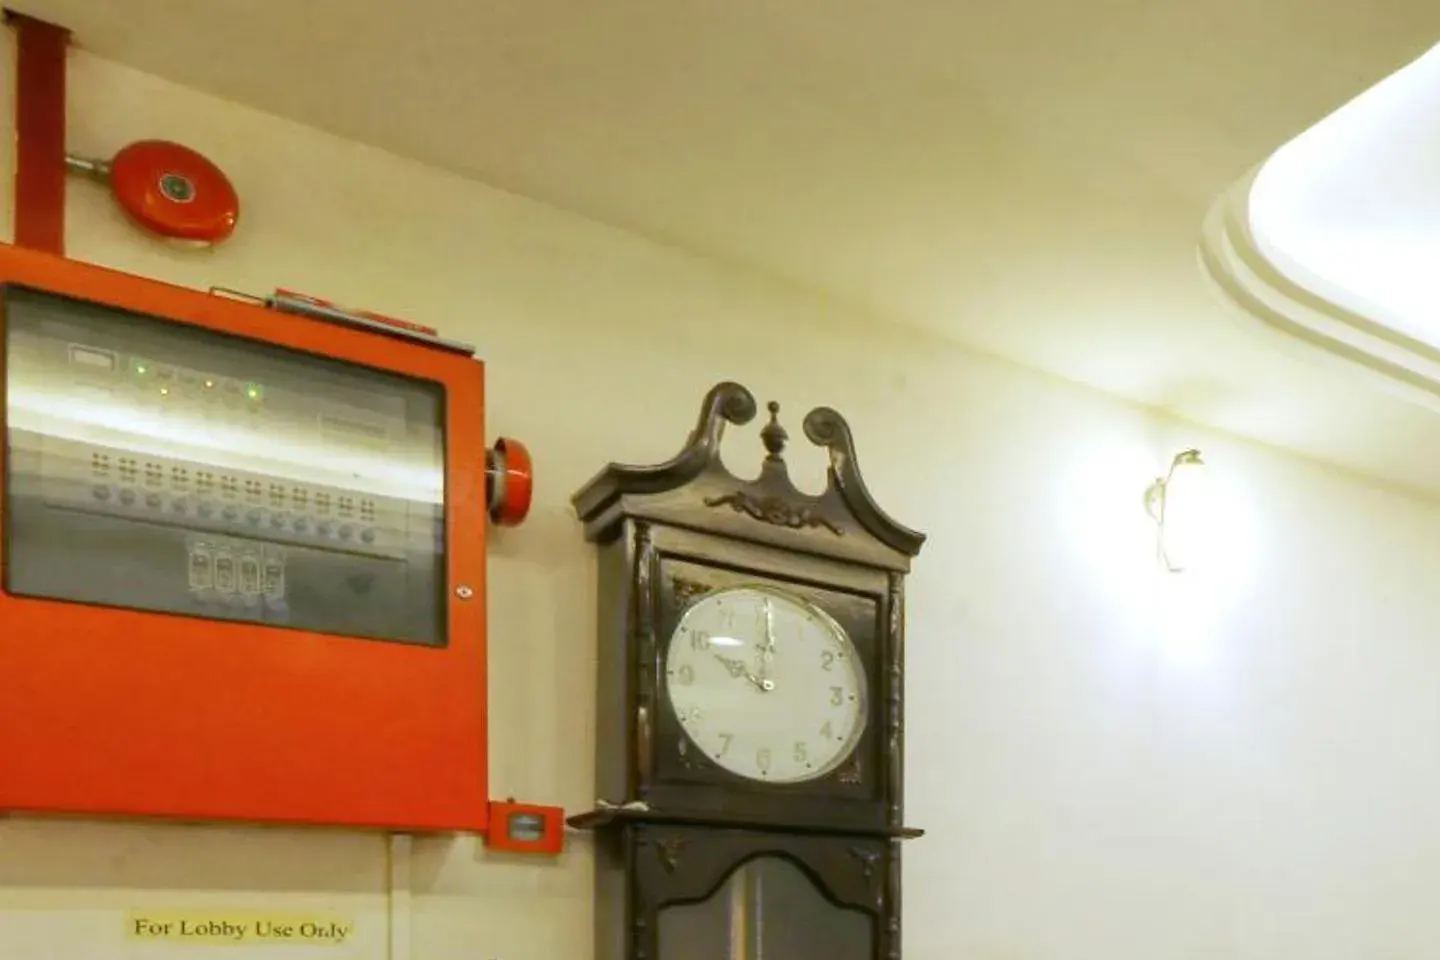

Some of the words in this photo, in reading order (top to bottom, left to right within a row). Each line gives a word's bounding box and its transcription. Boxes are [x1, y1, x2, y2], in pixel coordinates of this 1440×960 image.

[820, 650, 835, 672] 2
[678, 664, 695, 686] 9
[829, 686, 844, 707] 3
[819, 720, 833, 740] 4
[718, 733, 735, 753] 7
[793, 740, 807, 763] 5
[756, 748, 771, 770] 6
[134, 919, 172, 935] For
[179, 920, 247, 940] Lobby
[255, 921, 293, 938] Use
[299, 922, 349, 942] Only
